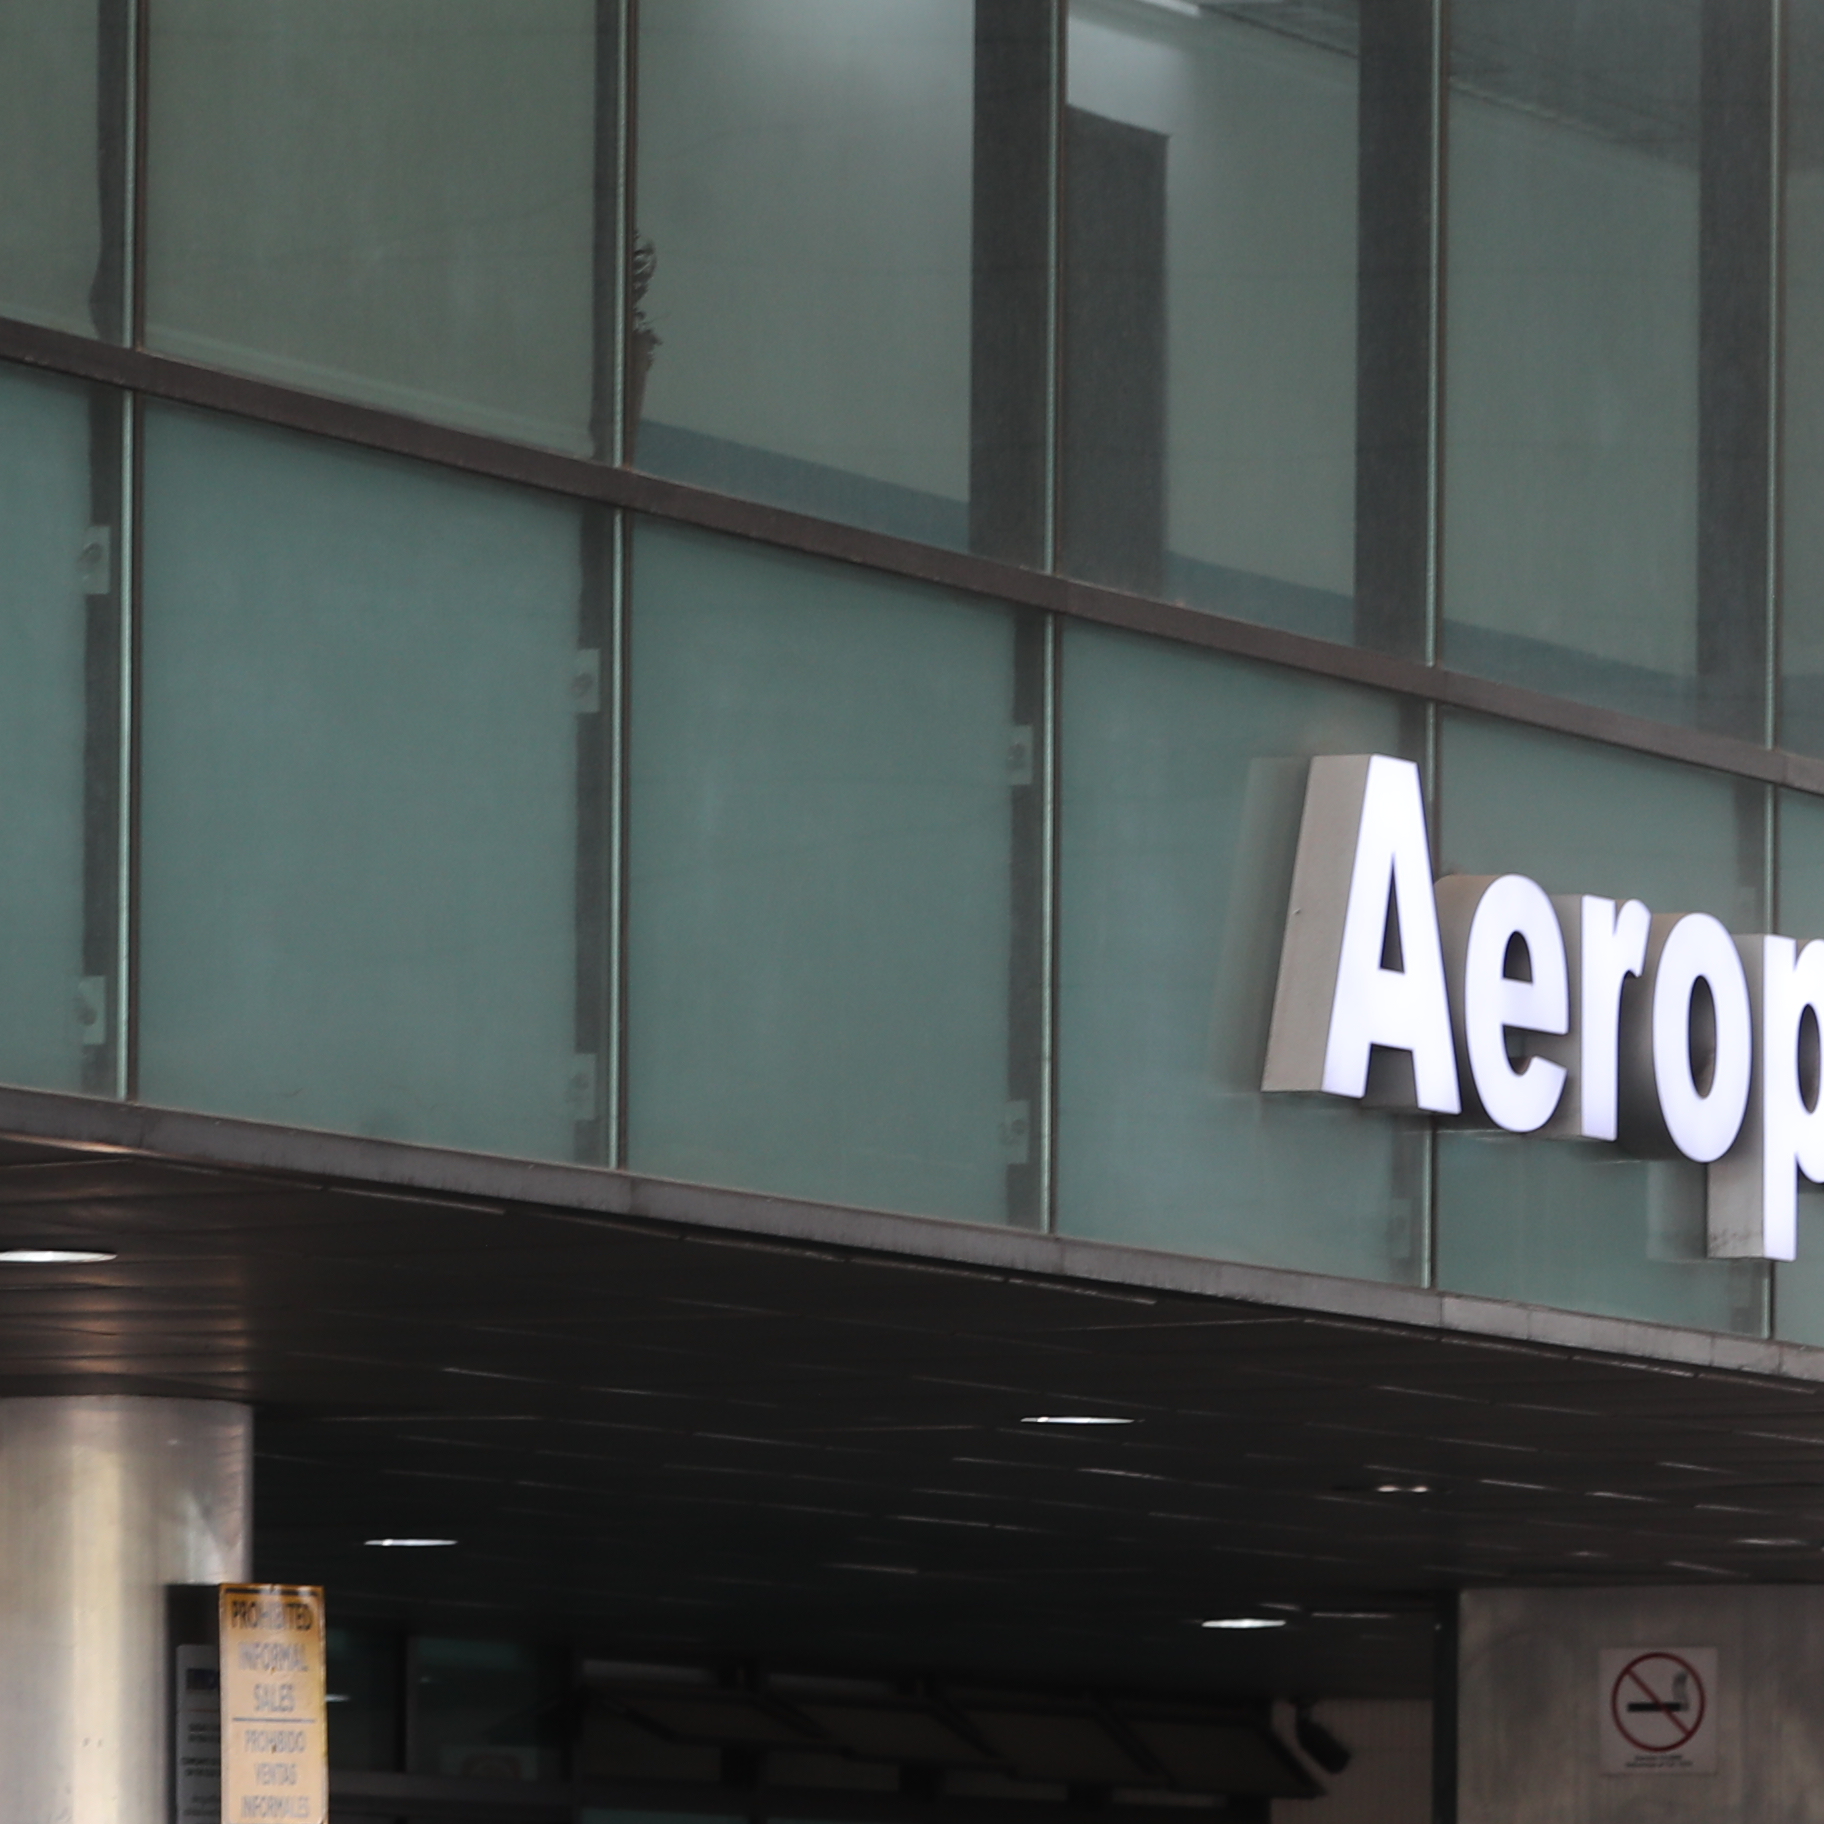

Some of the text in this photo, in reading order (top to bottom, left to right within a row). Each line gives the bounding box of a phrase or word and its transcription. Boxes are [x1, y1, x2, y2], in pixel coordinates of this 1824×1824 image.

[231, 1600, 313, 1631] PROHIBITED
[237, 1642, 308, 1673] INFORMAL
[253, 1684, 294, 1712] SALES
[243, 1730, 306, 1753] PROHIBIDO
[254, 1763, 298, 1786] VENTAS
[240, 1795, 309, 1819] INFORMALES
